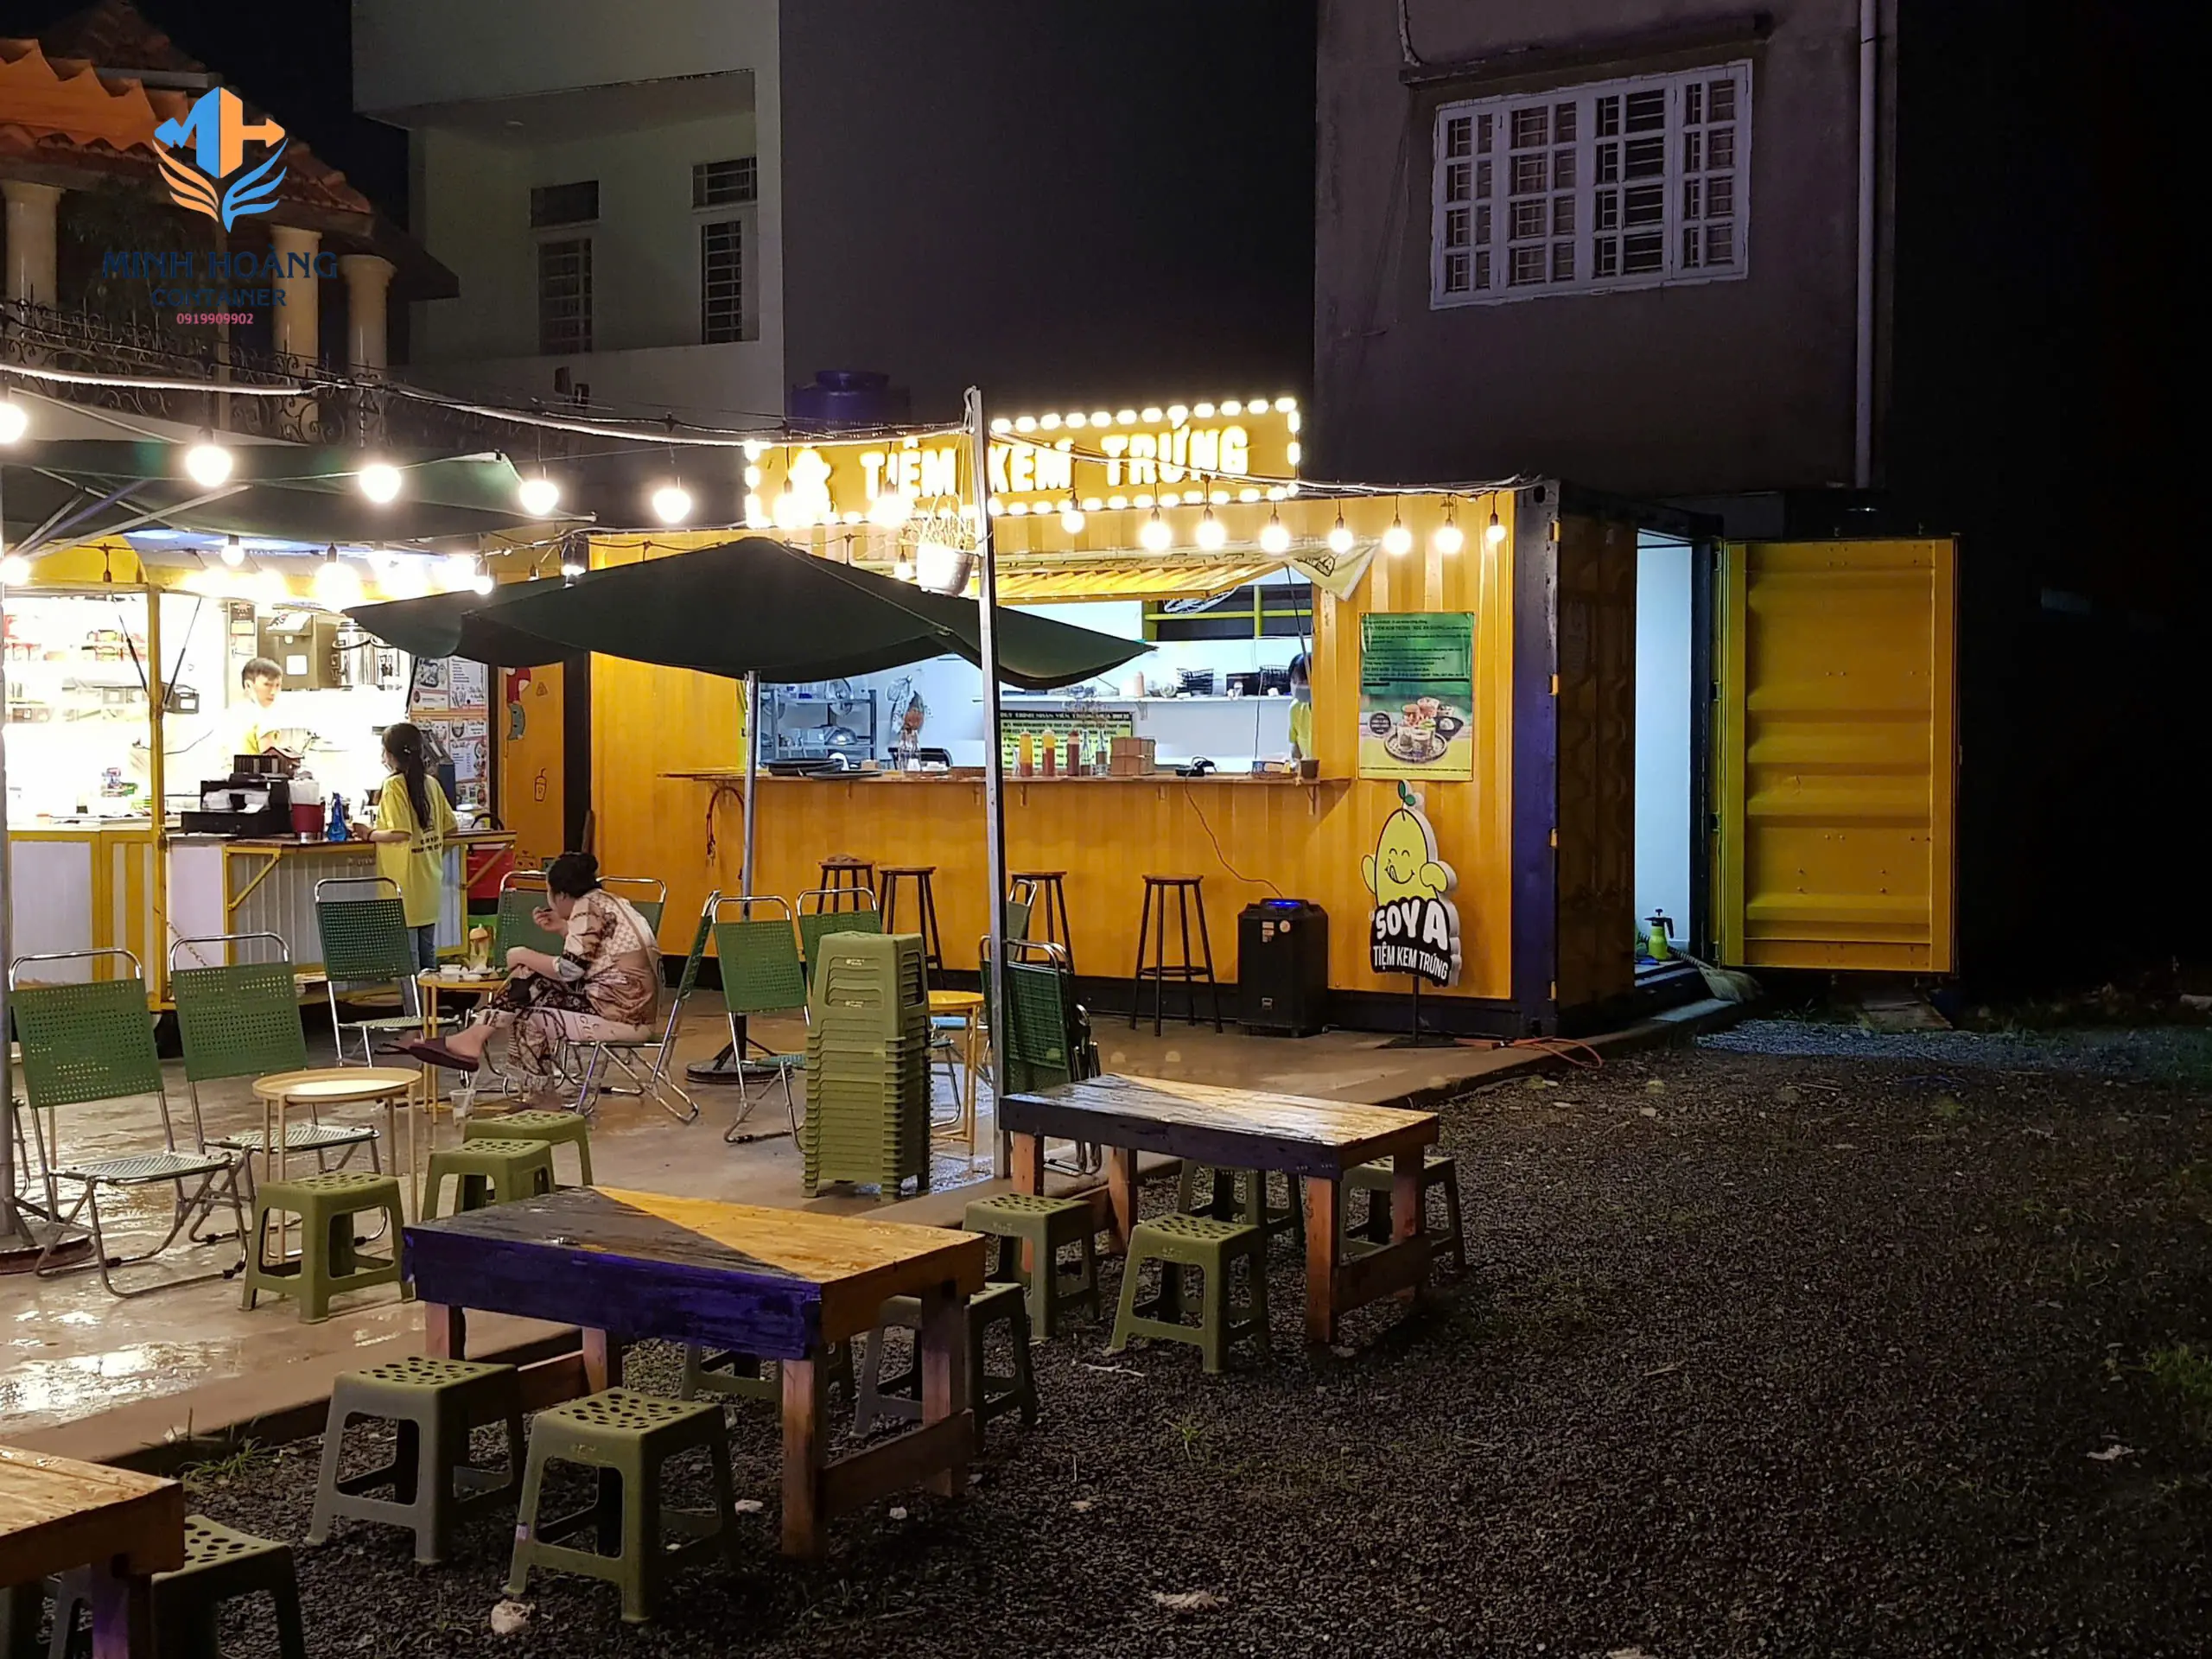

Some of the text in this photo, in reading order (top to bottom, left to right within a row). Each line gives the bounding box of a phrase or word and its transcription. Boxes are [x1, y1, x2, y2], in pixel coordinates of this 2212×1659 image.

[988, 442, 1072, 493] KEM
[1376, 899, 1448, 950] SOYA
[1373, 941, 1448, 980] TIỆM KEM TRỨNG
